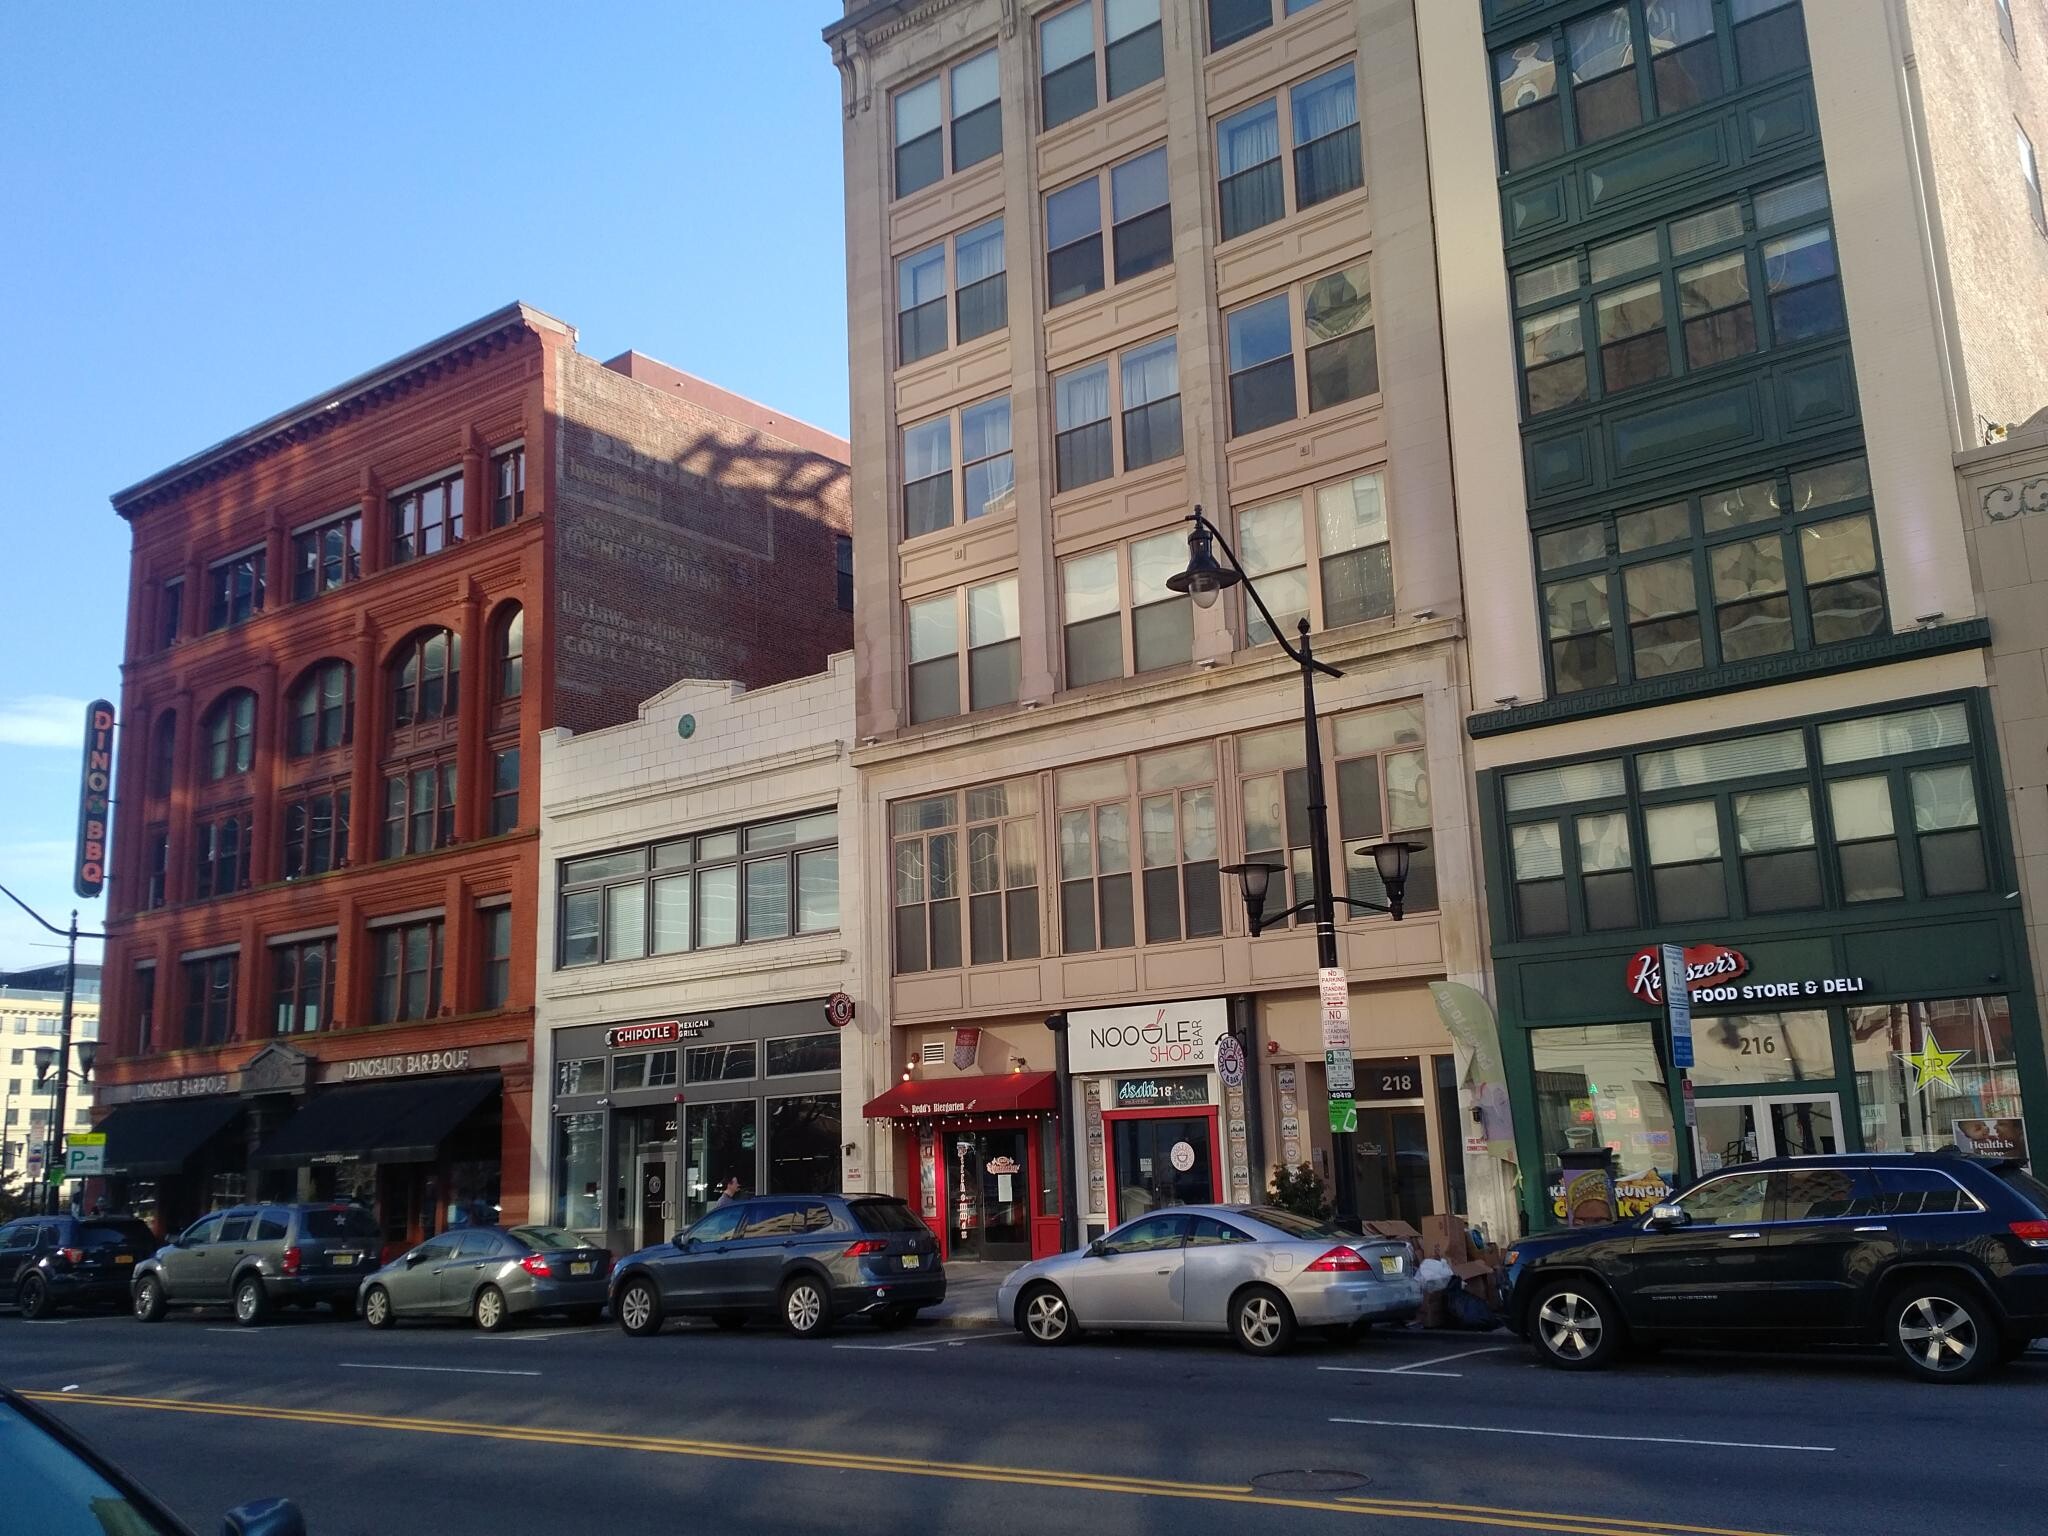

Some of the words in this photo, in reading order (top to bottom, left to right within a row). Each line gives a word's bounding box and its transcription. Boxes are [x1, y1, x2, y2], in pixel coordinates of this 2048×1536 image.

[88, 711, 113, 792] DINO
[82, 820, 103, 883] BBQ
[1633, 954, 1737, 1001] Krszer's
[1693, 985, 1738, 1003] FOOD
[1743, 982, 1800, 999] STORE
[1805, 981, 1818, 994] &
[1823, 977, 1864, 993] DELI
[679, 1019, 709, 1029] MEXICAN
[1328, 1010, 1341, 1020] NO
[617, 1026, 670, 1042] CHIPOTLE
[679, 1030, 698, 1038] GRILL
[1091, 1021, 1191, 1048] NOODLE
[1192, 1019, 1203, 1046] BAR
[1150, 1044, 1191, 1063] SHOP
[1741, 1036, 1775, 1055] 216
[346, 1058, 402, 1079] DINOSAUR
[1119, 1080, 1155, 1100] Asahi
[1153, 1086, 1172, 1098] 218
[1382, 1076, 1411, 1091] 218
[911, 1104, 931, 1114] Redd's
[933, 1102, 964, 1113] Biergarten
[1969, 1139, 2003, 1149] Health
[2004, 1139, 2014, 1149] is
[71, 1151, 85, 1169] P
[1614, 1185, 1675, 1198] RUNCHY
